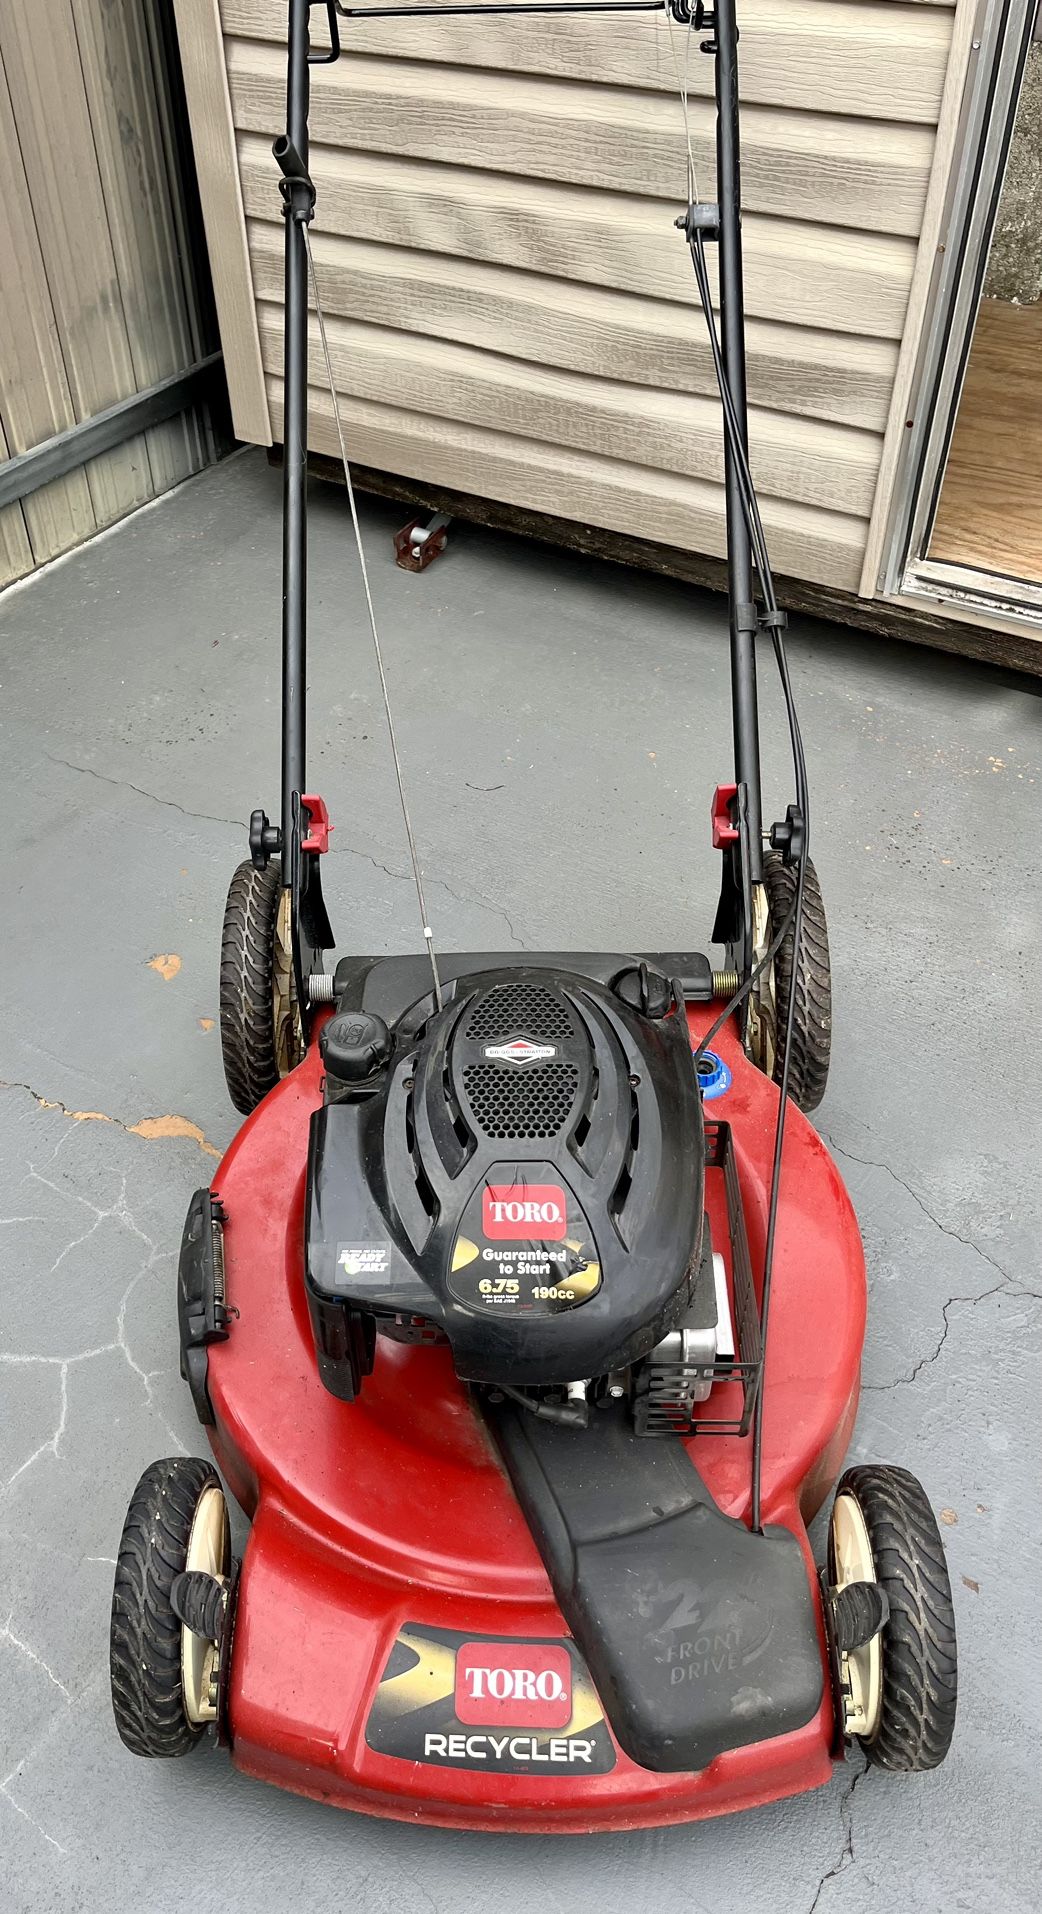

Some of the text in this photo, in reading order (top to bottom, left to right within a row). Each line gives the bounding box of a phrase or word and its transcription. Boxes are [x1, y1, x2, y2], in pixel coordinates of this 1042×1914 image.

[338, 1253, 386, 1264] READY
[482, 1248, 567, 1262] Guaranteed
[499, 1261, 551, 1274] to Start
[478, 1278, 520, 1294] 6.75
[531, 1286, 575, 1299] 190cc
[666, 1628, 742, 1663] FRONT
[670, 1652, 738, 1685] DRIVE
